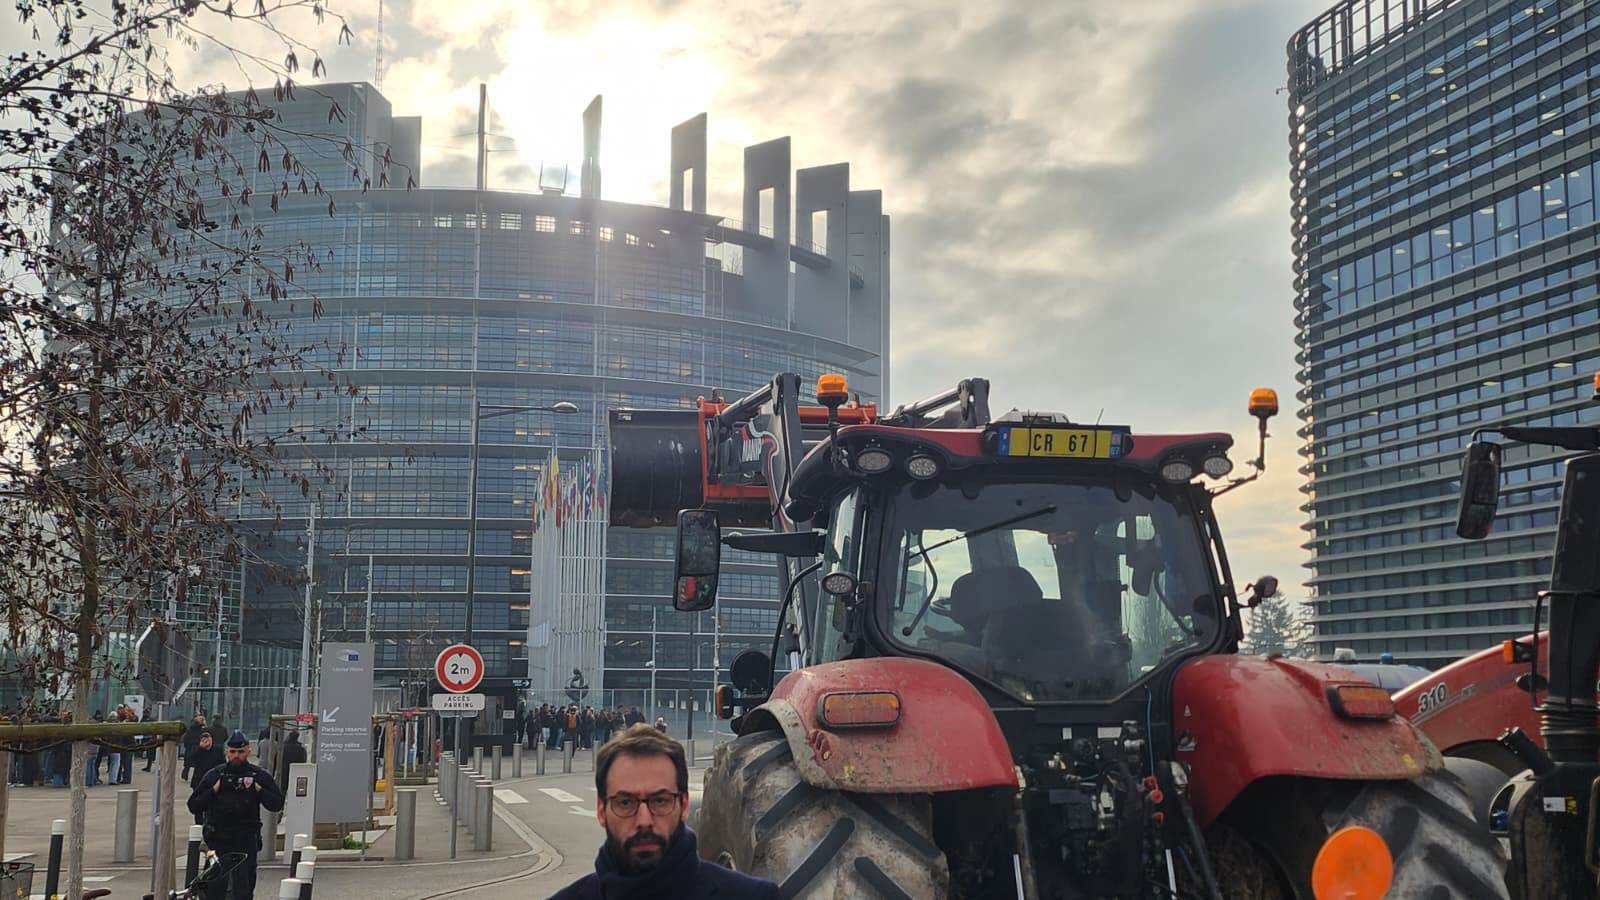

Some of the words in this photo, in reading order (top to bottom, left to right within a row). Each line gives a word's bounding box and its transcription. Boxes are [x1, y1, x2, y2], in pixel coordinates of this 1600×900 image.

[1033, 433, 1053, 451] CR
[1068, 434, 1088, 453] 67
[451, 663, 470, 675] 2m
[1418, 682, 1447, 714] 310
